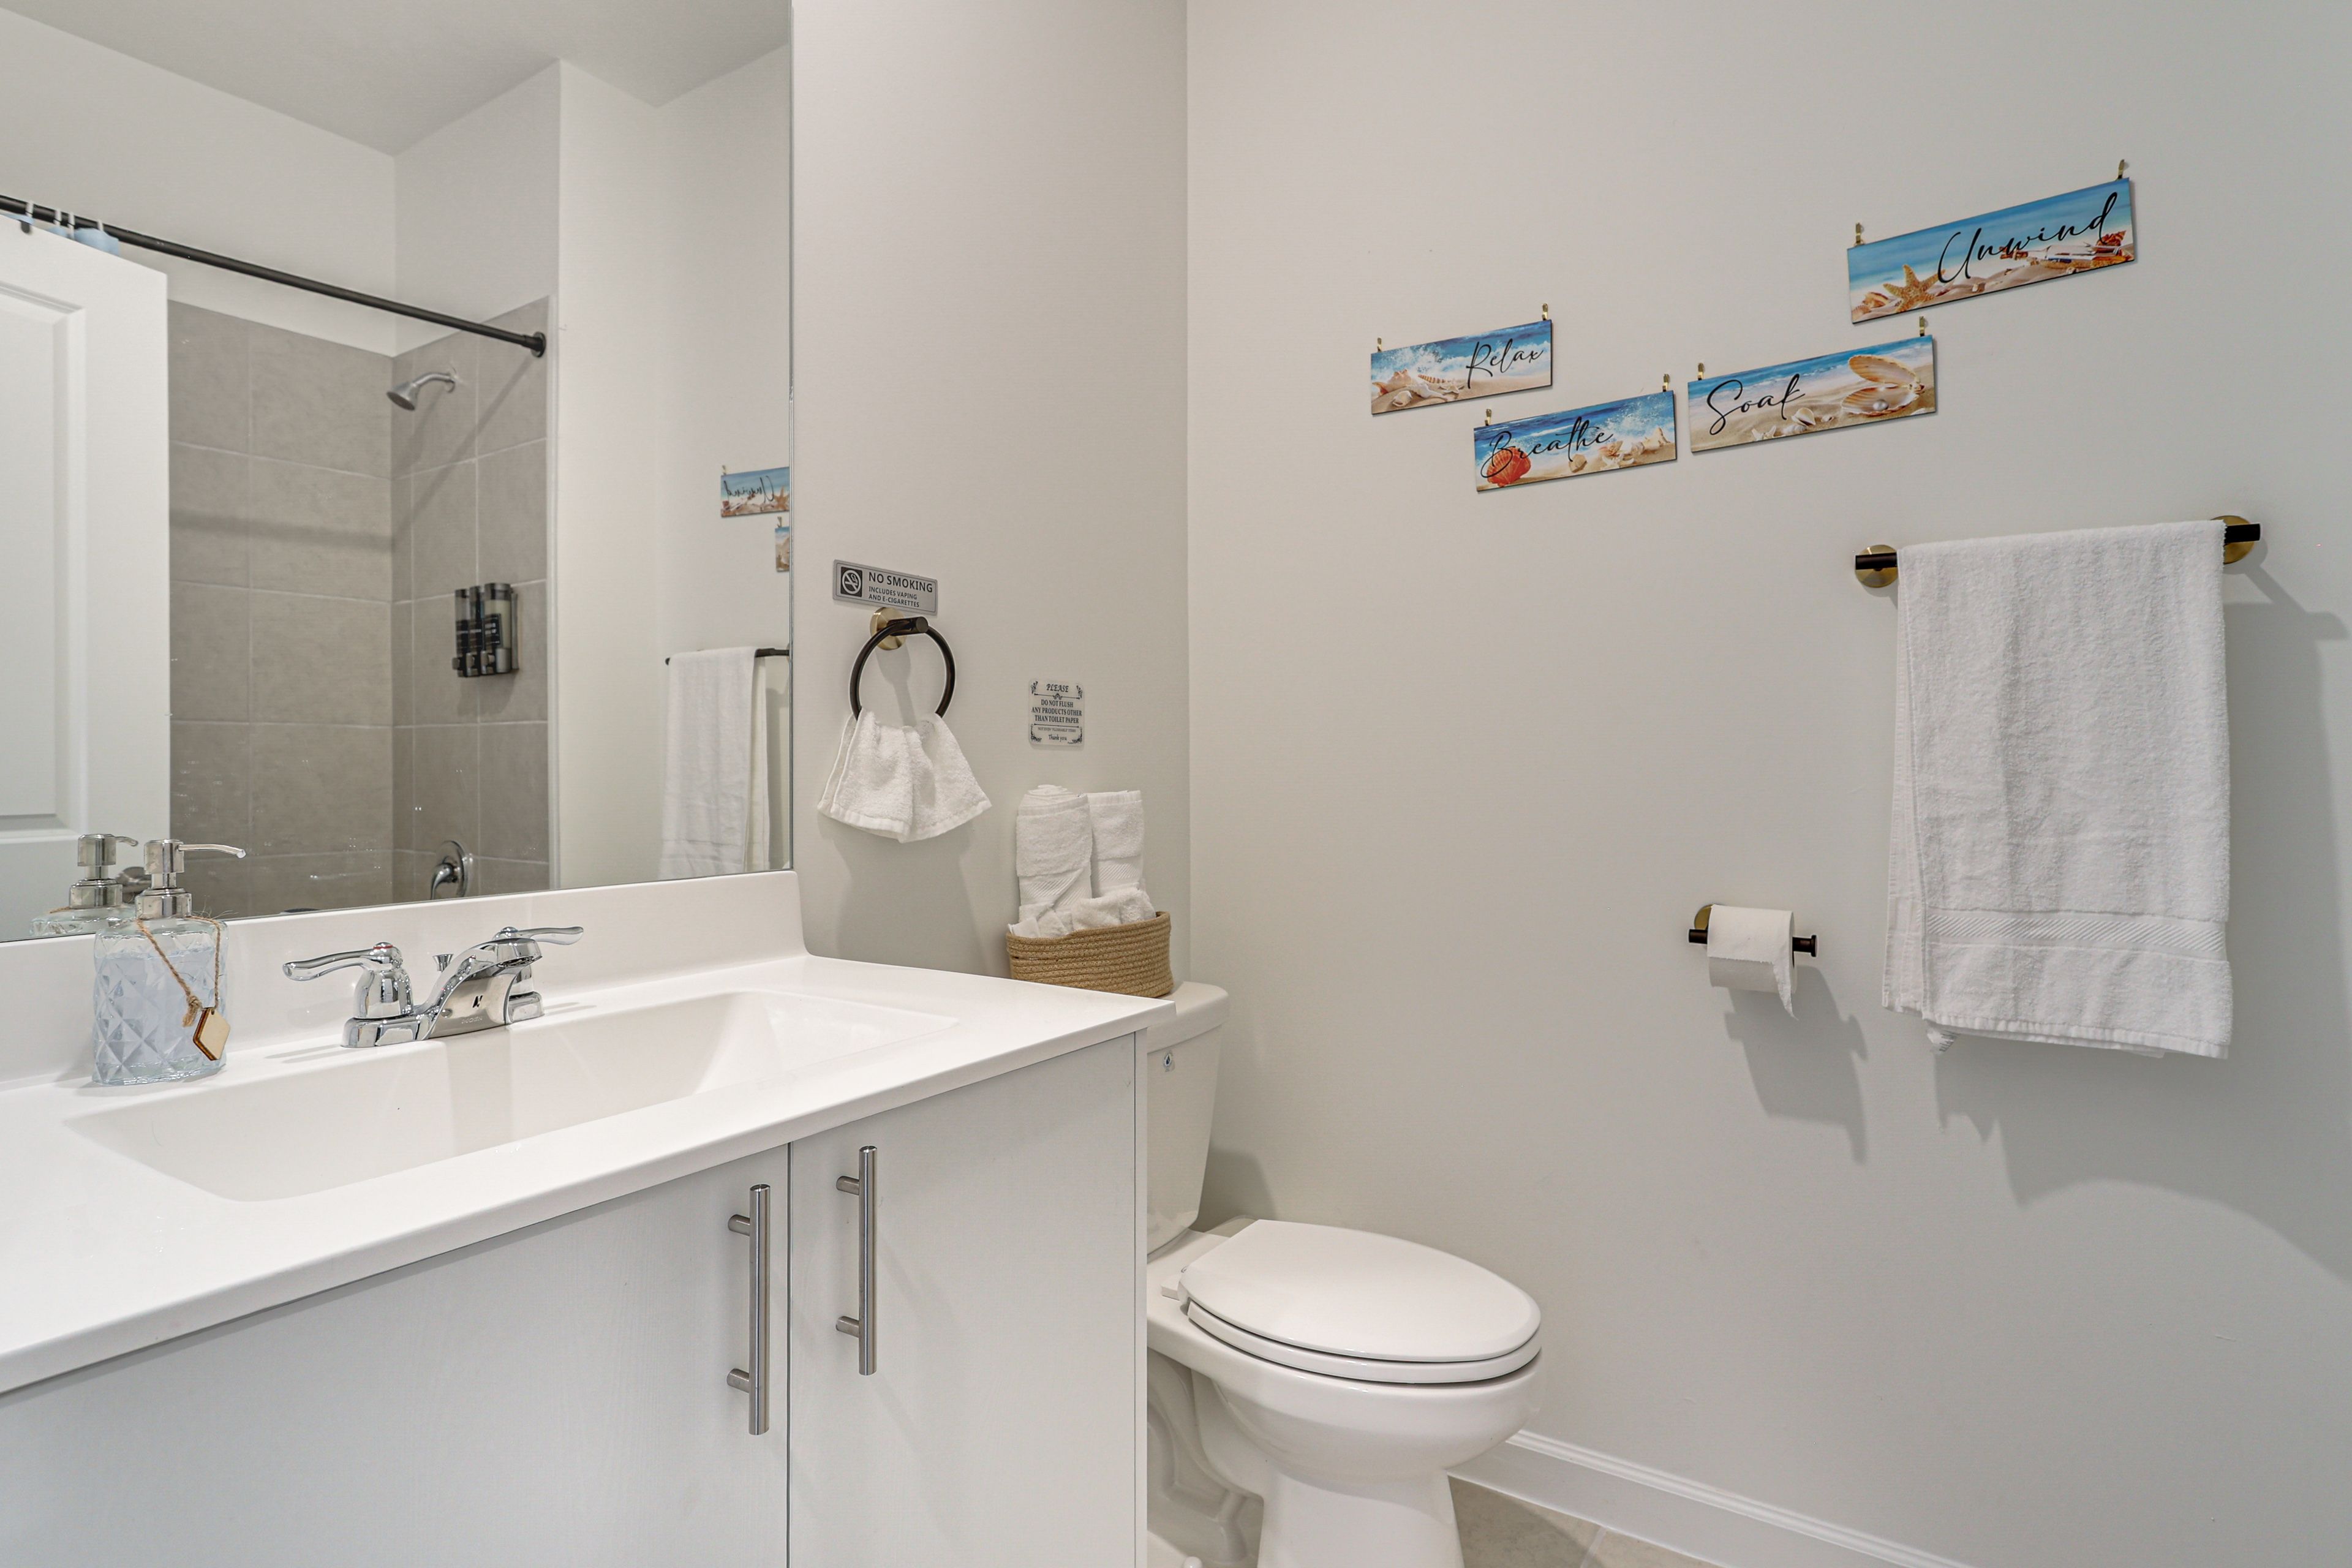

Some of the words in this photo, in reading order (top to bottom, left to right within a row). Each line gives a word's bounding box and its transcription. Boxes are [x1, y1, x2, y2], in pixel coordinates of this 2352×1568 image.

[1937, 192, 2118, 284] Unwind
[1466, 338, 1544, 389] Relax
[1706, 373, 1806, 435] Soak
[1480, 417, 1613, 478] Breathe
[869, 571, 884, 583] NO
[887, 575, 933, 592] SMOKING
[869, 586, 896, 596] INCLUDES
[882, 596, 920, 608] E-CIGARETTES
[1046, 684, 1069, 692] PLEASE
